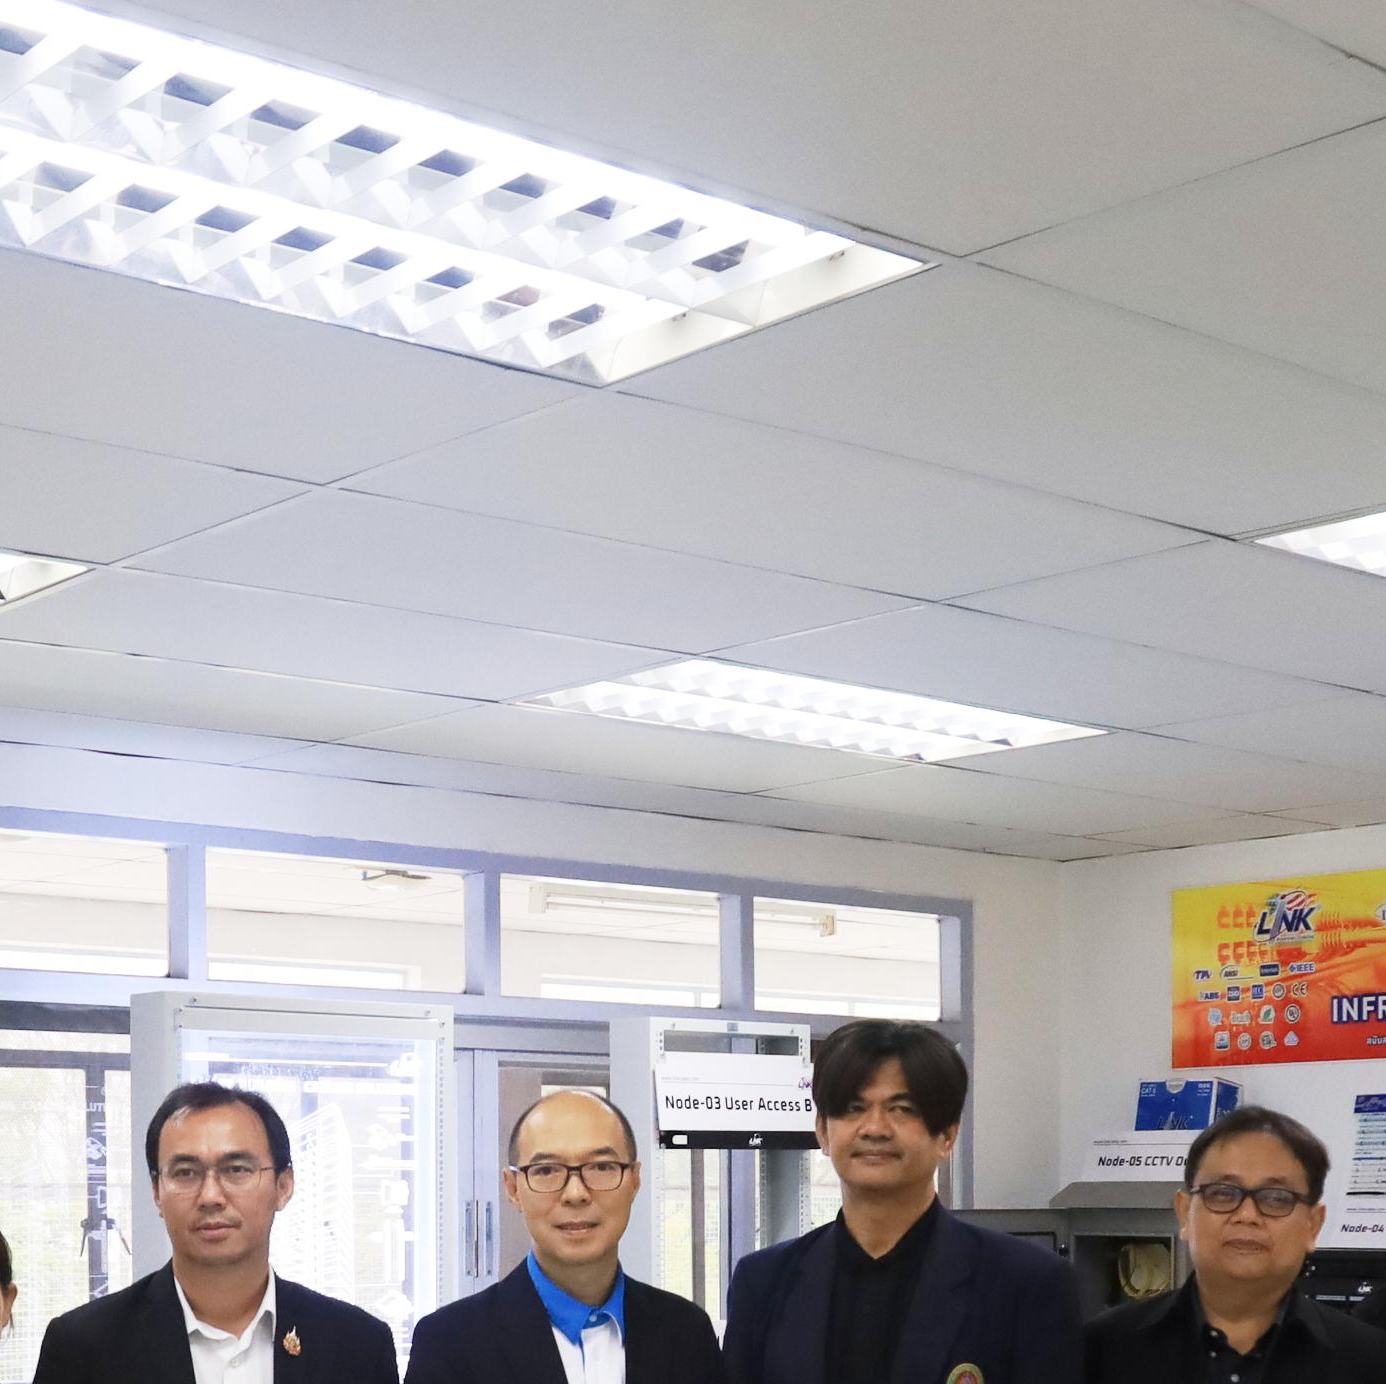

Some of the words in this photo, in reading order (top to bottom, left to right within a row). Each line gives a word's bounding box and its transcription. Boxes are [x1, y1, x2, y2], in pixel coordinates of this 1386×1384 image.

[1256, 896, 1316, 939] LINK
[665, 1096, 721, 1111] Node-03
[725, 1097, 753, 1111] User
[758, 1098, 801, 1112] Access
[805, 1099, 812, 1112] B
[1098, 1155, 1142, 1167] Node-05
[1144, 1156, 1174, 1167] CCTV
[1341, 1224, 1383, 1233] Node-04
